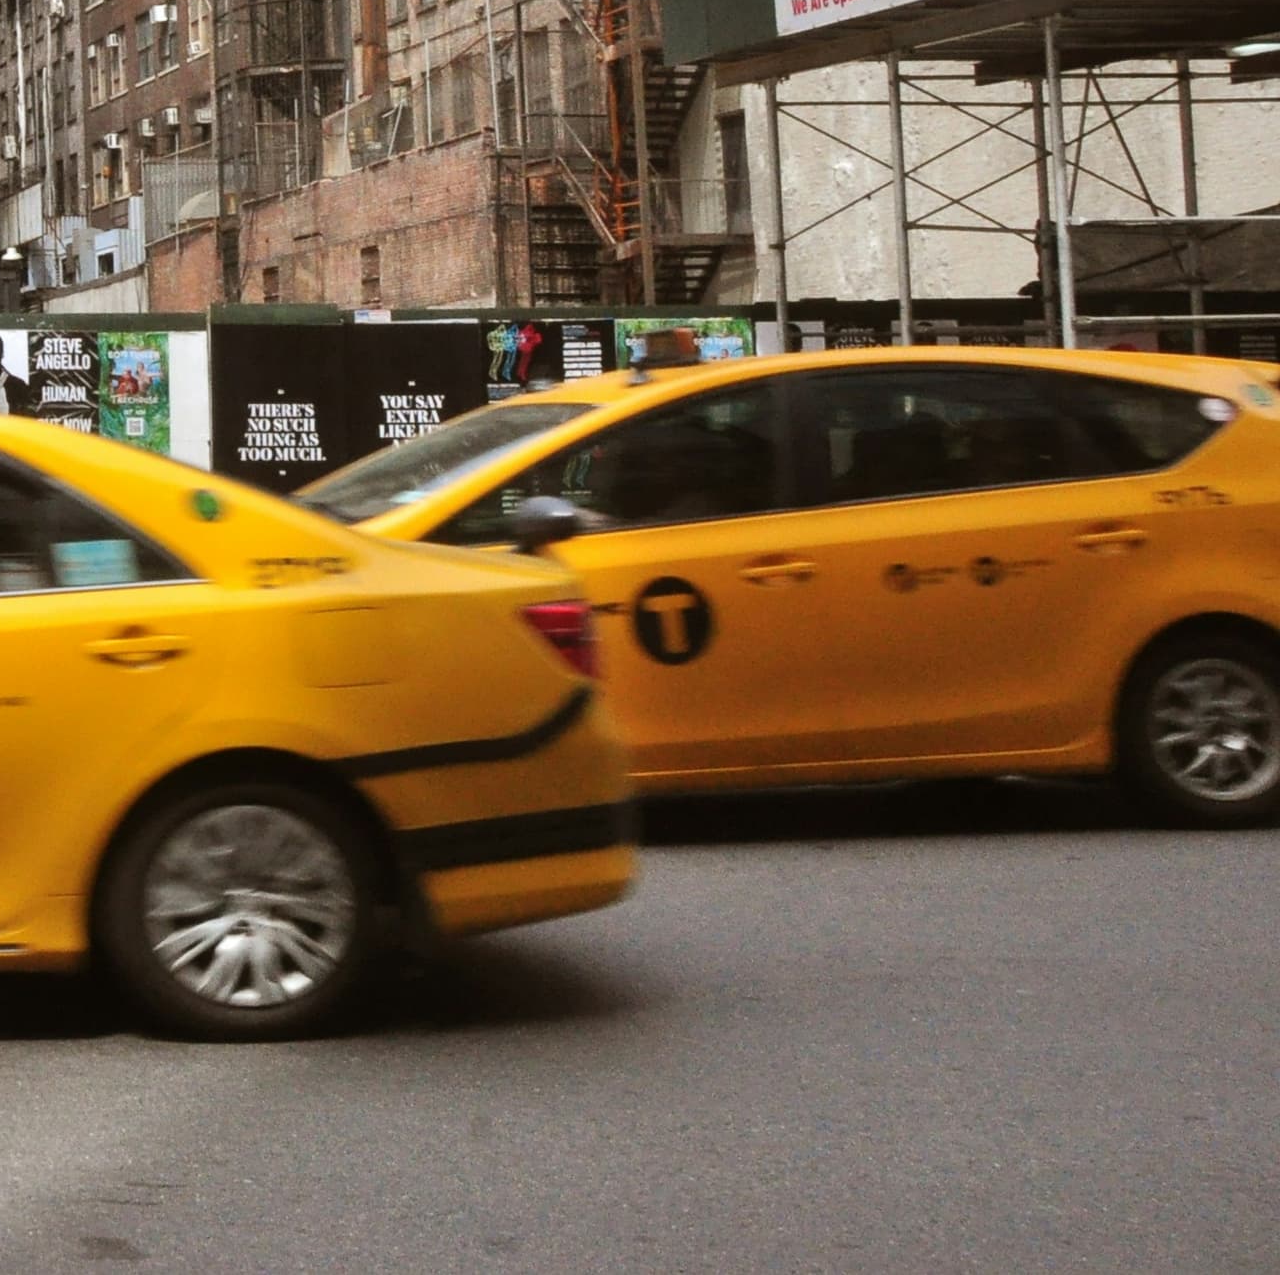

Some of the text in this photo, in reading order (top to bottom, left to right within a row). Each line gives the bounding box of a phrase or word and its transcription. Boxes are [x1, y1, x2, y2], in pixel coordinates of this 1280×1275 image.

[43, 338, 83, 354] STEVE
[36, 354, 91, 370] ANGELLO
[42, 386, 86, 403] HUMAN
[379, 395, 445, 410] YOU SAY
[247, 403, 315, 418] THERE'S
[385, 409, 441, 424] EXTRA
[247, 418, 316, 432] NO SUCH
[378, 424, 416, 439] LIKE
[244, 432, 320, 447] THING AS
[237, 447, 327, 462] TOO MUCH.
[642, 593, 696, 653] T
